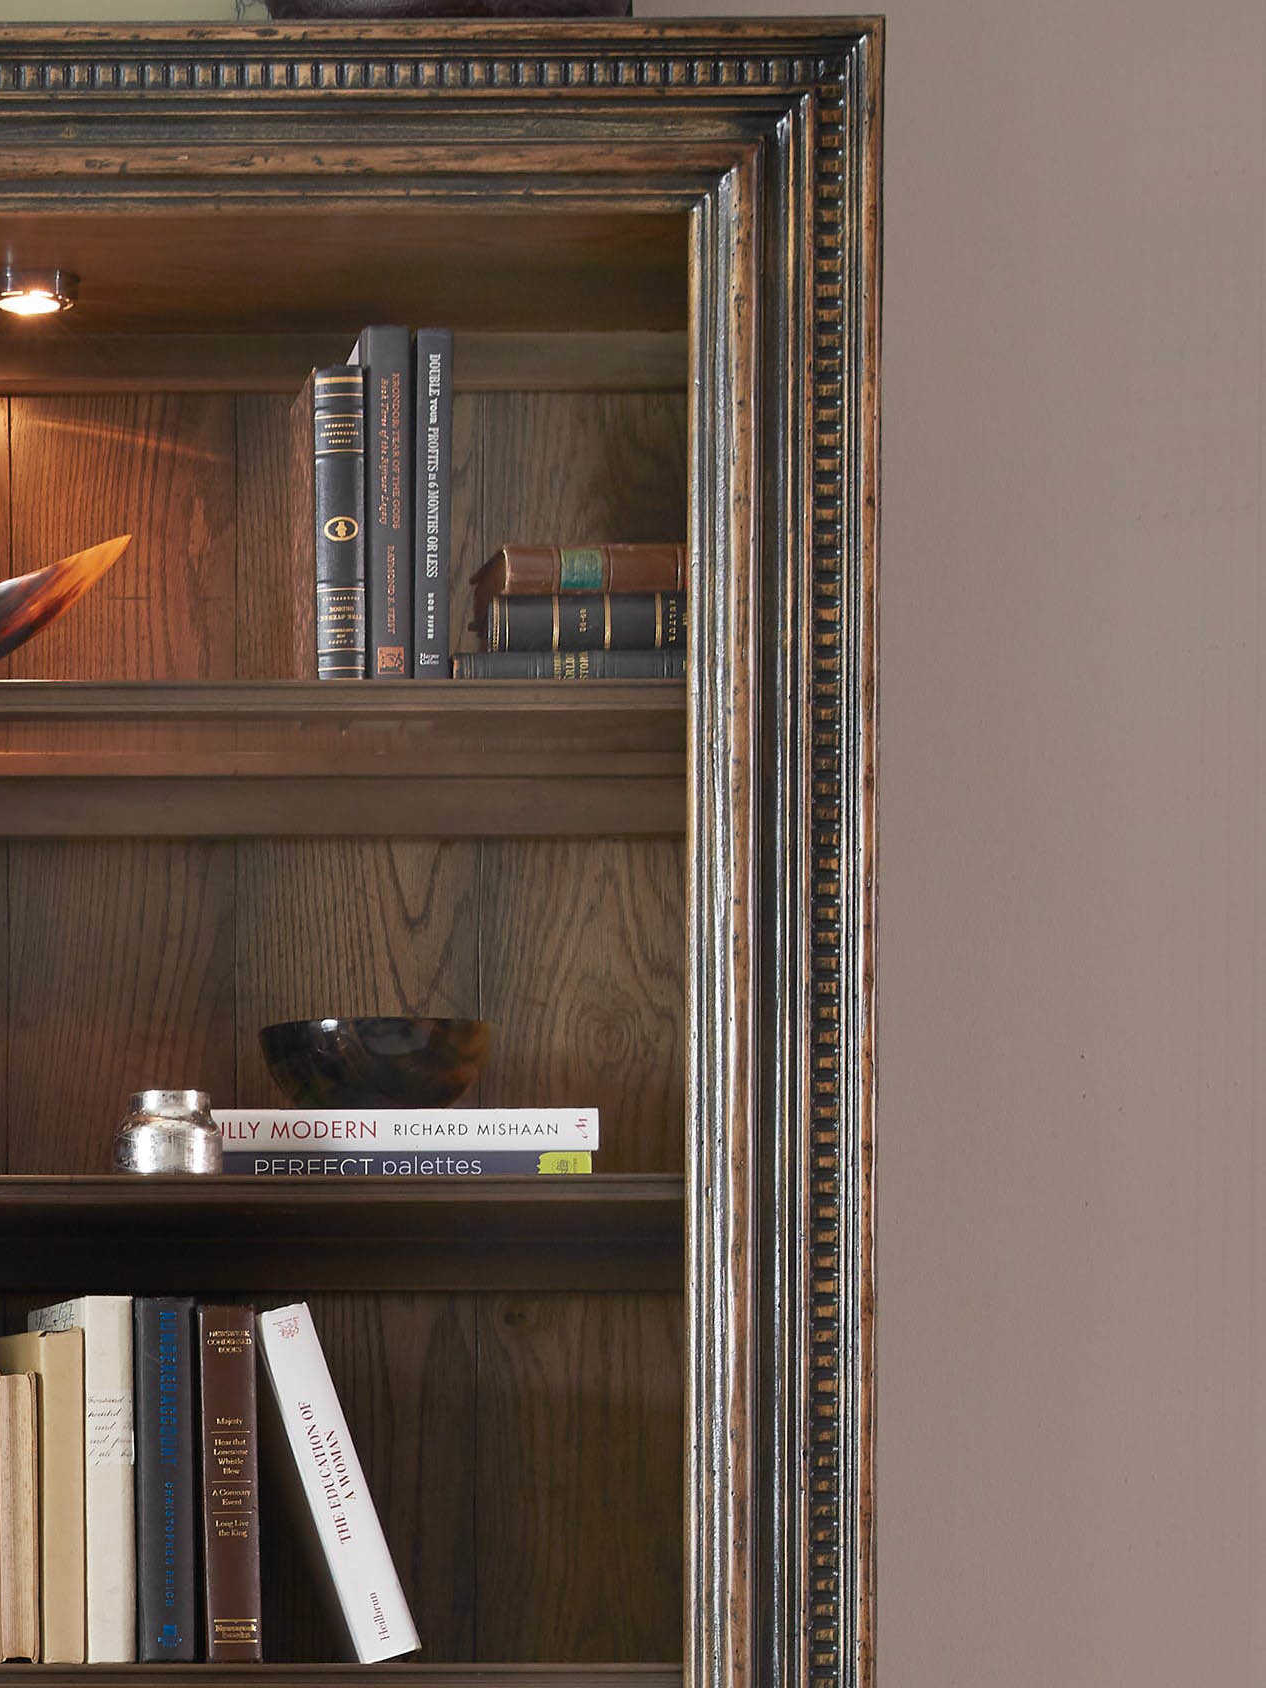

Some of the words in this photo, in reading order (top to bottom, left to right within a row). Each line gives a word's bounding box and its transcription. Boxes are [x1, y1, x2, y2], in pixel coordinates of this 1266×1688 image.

[428, 354, 441, 397] DOUBLE
[427, 427, 439, 472] PROFITS
[427, 481, 439, 489] 6
[426, 490, 439, 534] MONTHS
[426, 536, 439, 552] OR
[426, 553, 438, 578] LESS
[270, 1120, 377, 1139] MODERN
[394, 1123, 468, 1136] RICHARD
[477, 1122, 559, 1136] MISHAAN
[254, 1158, 374, 1175] PERFECT
[382, 1156, 482, 1175] palettes
[216, 1418, 243, 1426] Majesty
[298, 1402, 313, 1420] OF
[305, 1424, 342, 1509] EDUCATION
[324, 1430, 352, 1488] WOMAN
[333, 1512, 351, 1545] THE
[369, 1592, 390, 1641] Heilbrun
